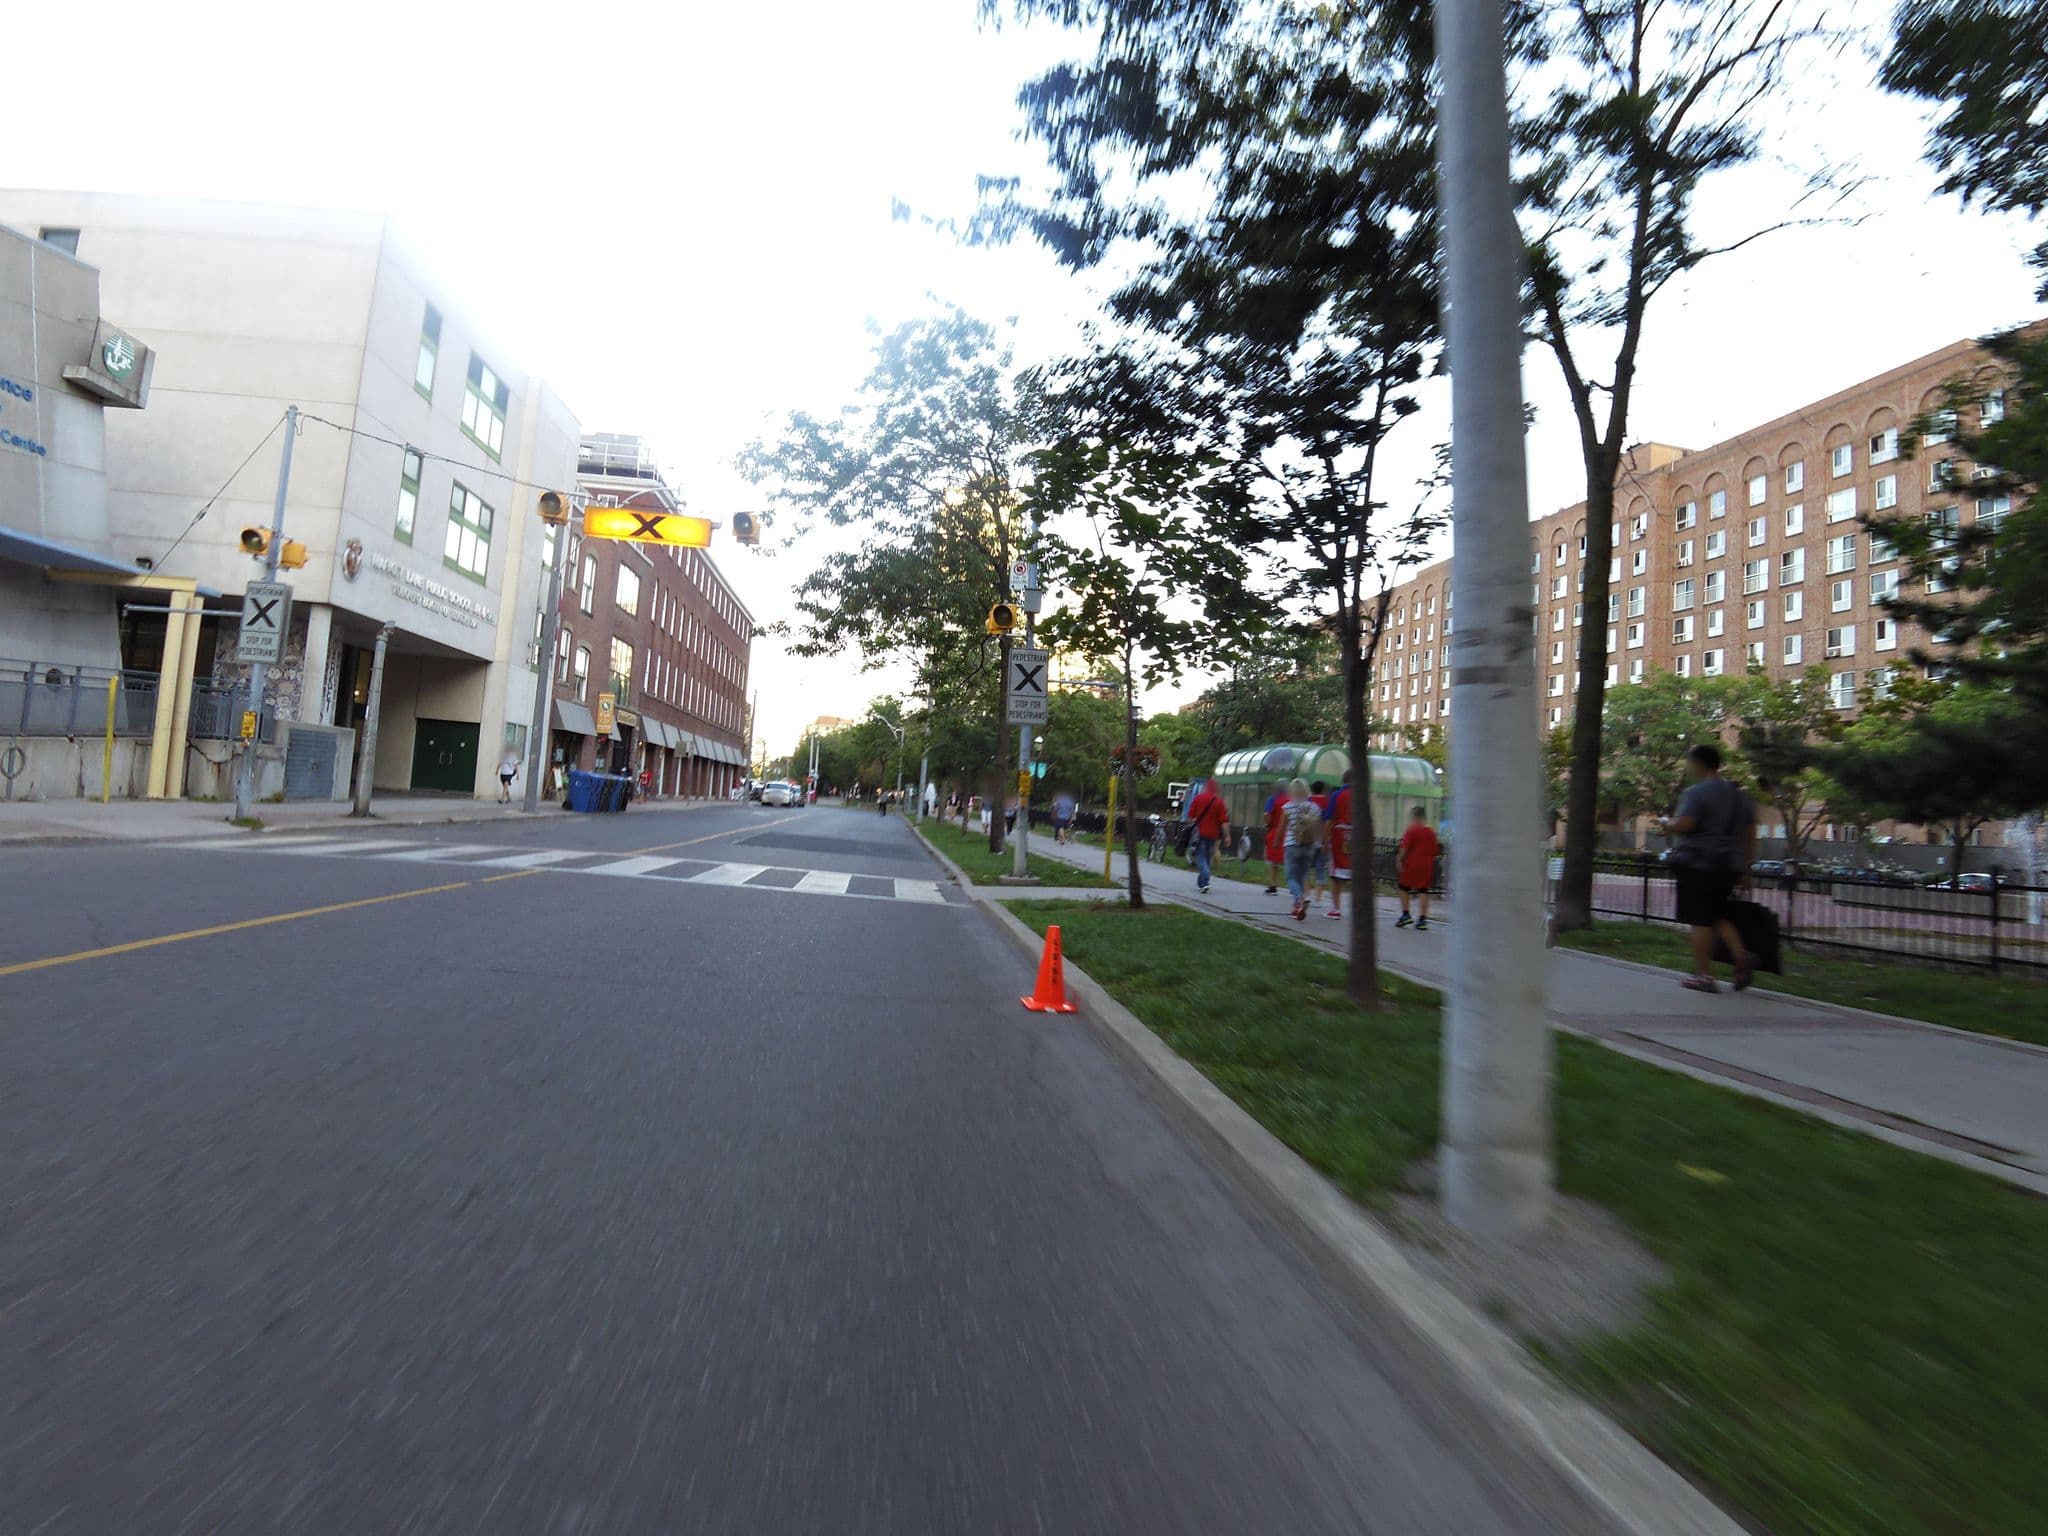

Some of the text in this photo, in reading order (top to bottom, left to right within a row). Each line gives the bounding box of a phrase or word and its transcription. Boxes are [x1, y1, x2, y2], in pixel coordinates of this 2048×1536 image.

[0, 377, 32, 401] nce
[630, 513, 667, 539] X
[246, 598, 279, 629] X
[240, 647, 276, 657] PEDESTRIANS
[1012, 653, 1046, 663] PEDESTRIAN
[1014, 663, 1044, 692] X
[1015, 700, 1041, 709] STOP FOR
[1008, 710, 1045, 720] PEDESTRIANS
